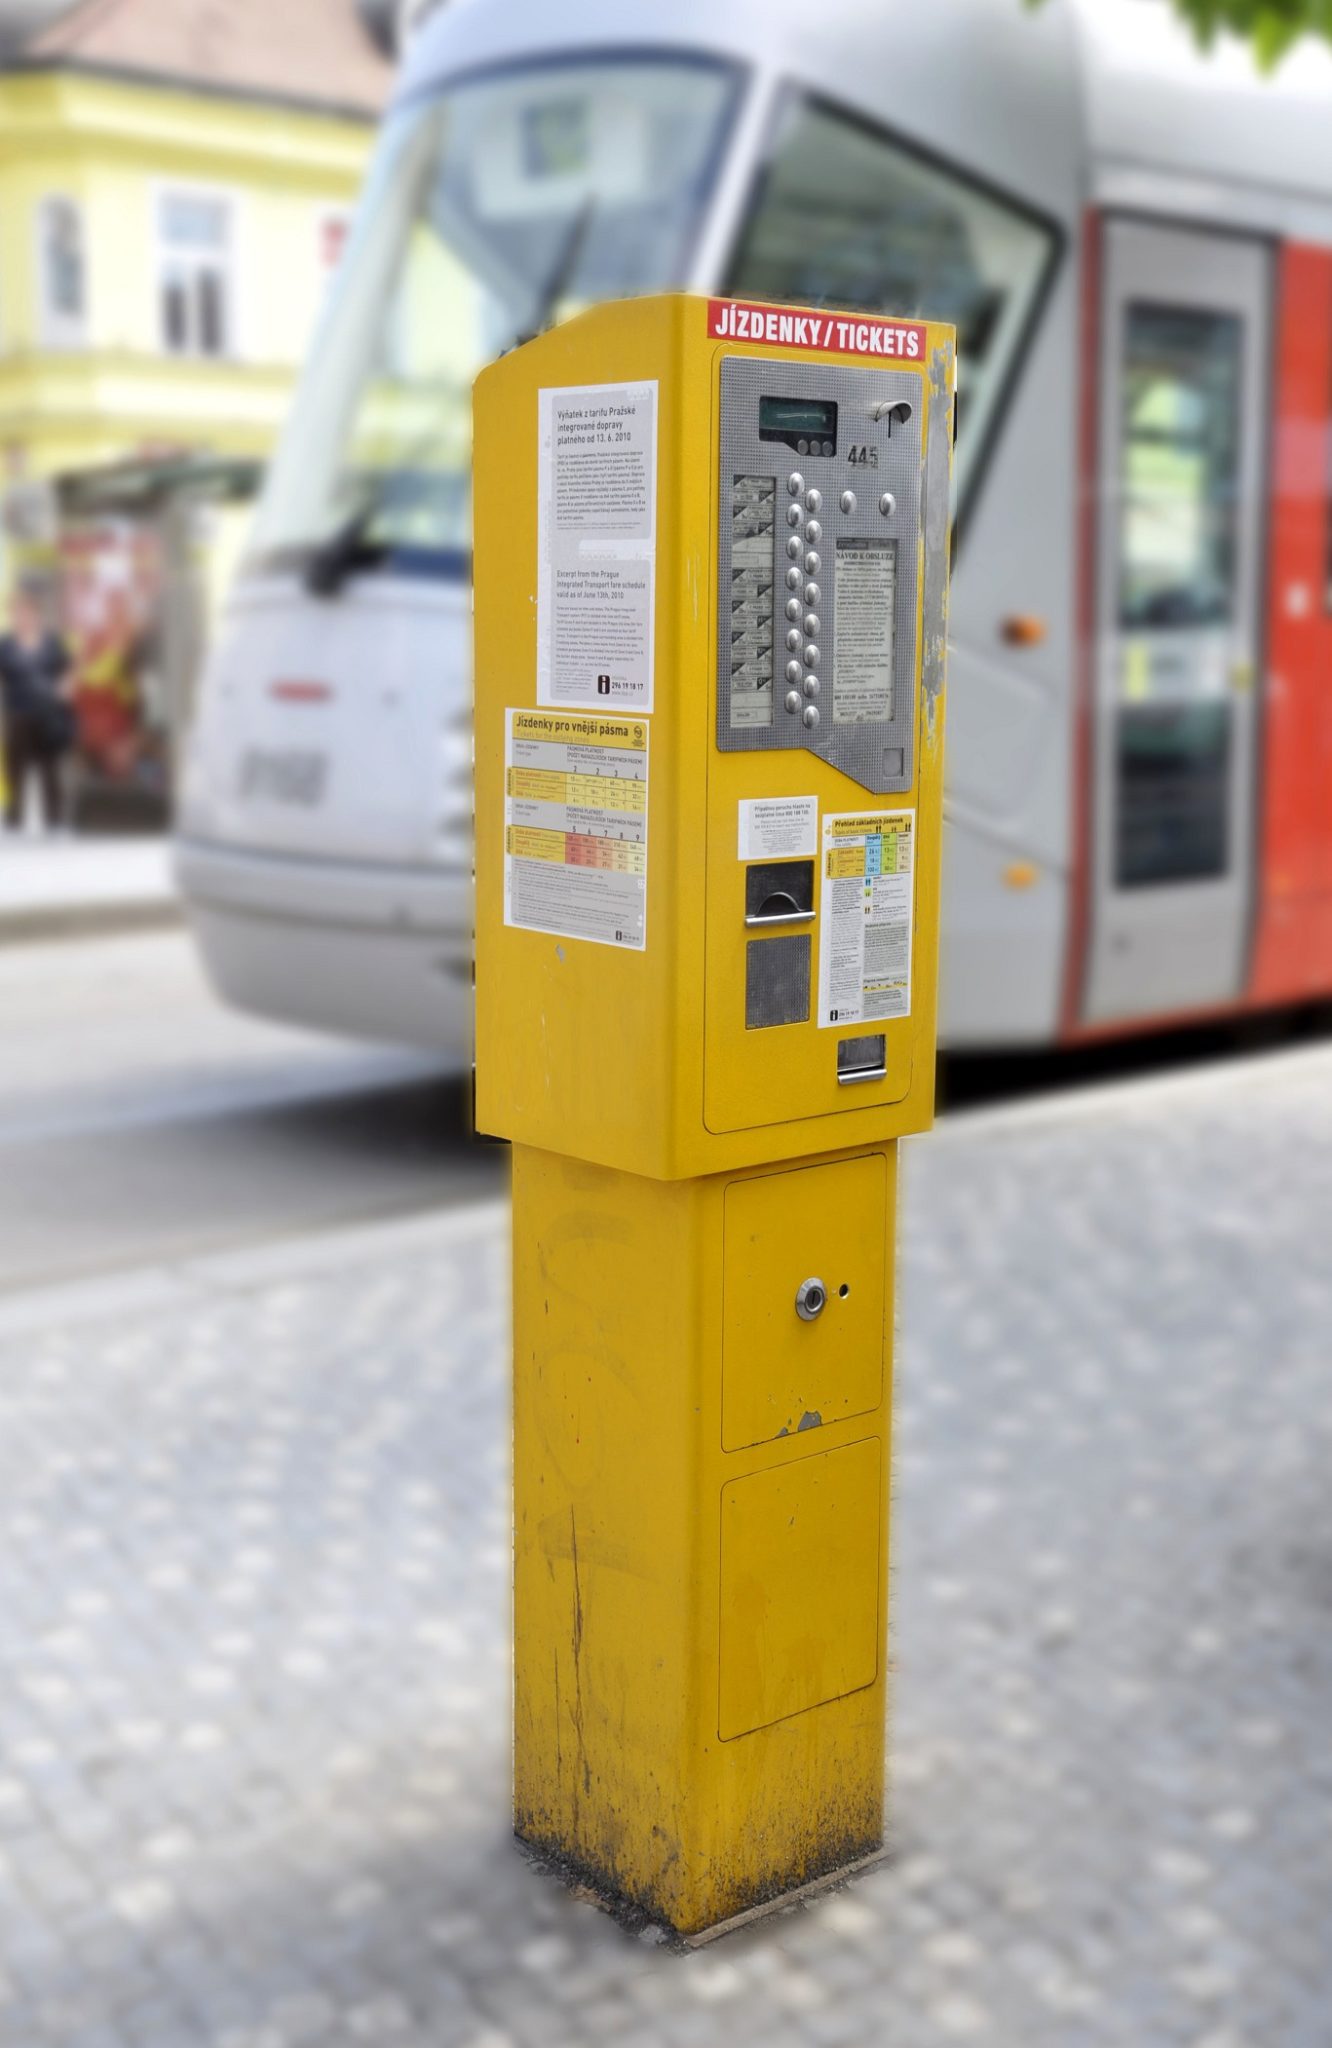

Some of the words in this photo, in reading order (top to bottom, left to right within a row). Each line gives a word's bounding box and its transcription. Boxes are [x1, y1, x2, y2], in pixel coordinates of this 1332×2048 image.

[715, 304, 821, 345] JÍZDENKY
[837, 323, 919, 357] TICKETS
[589, 408, 608, 418] tarifu
[609, 404, 636, 416] Pražské
[557, 421, 595, 433] integrované
[596, 421, 623, 432] dopravy
[586, 434, 595, 443] od
[615, 432, 632, 442] 2010
[848, 445, 879, 468] 445
[556, 570, 576, 578] Excerpt
[578, 570, 590, 578] from
[590, 570, 600, 578] the
[600, 570, 620, 580] Prague
[516, 715, 553, 732] Jízdenky
[555, 721, 570, 732] pro
[572, 720, 597, 736] vnější
[600, 722, 628, 740] pásma
